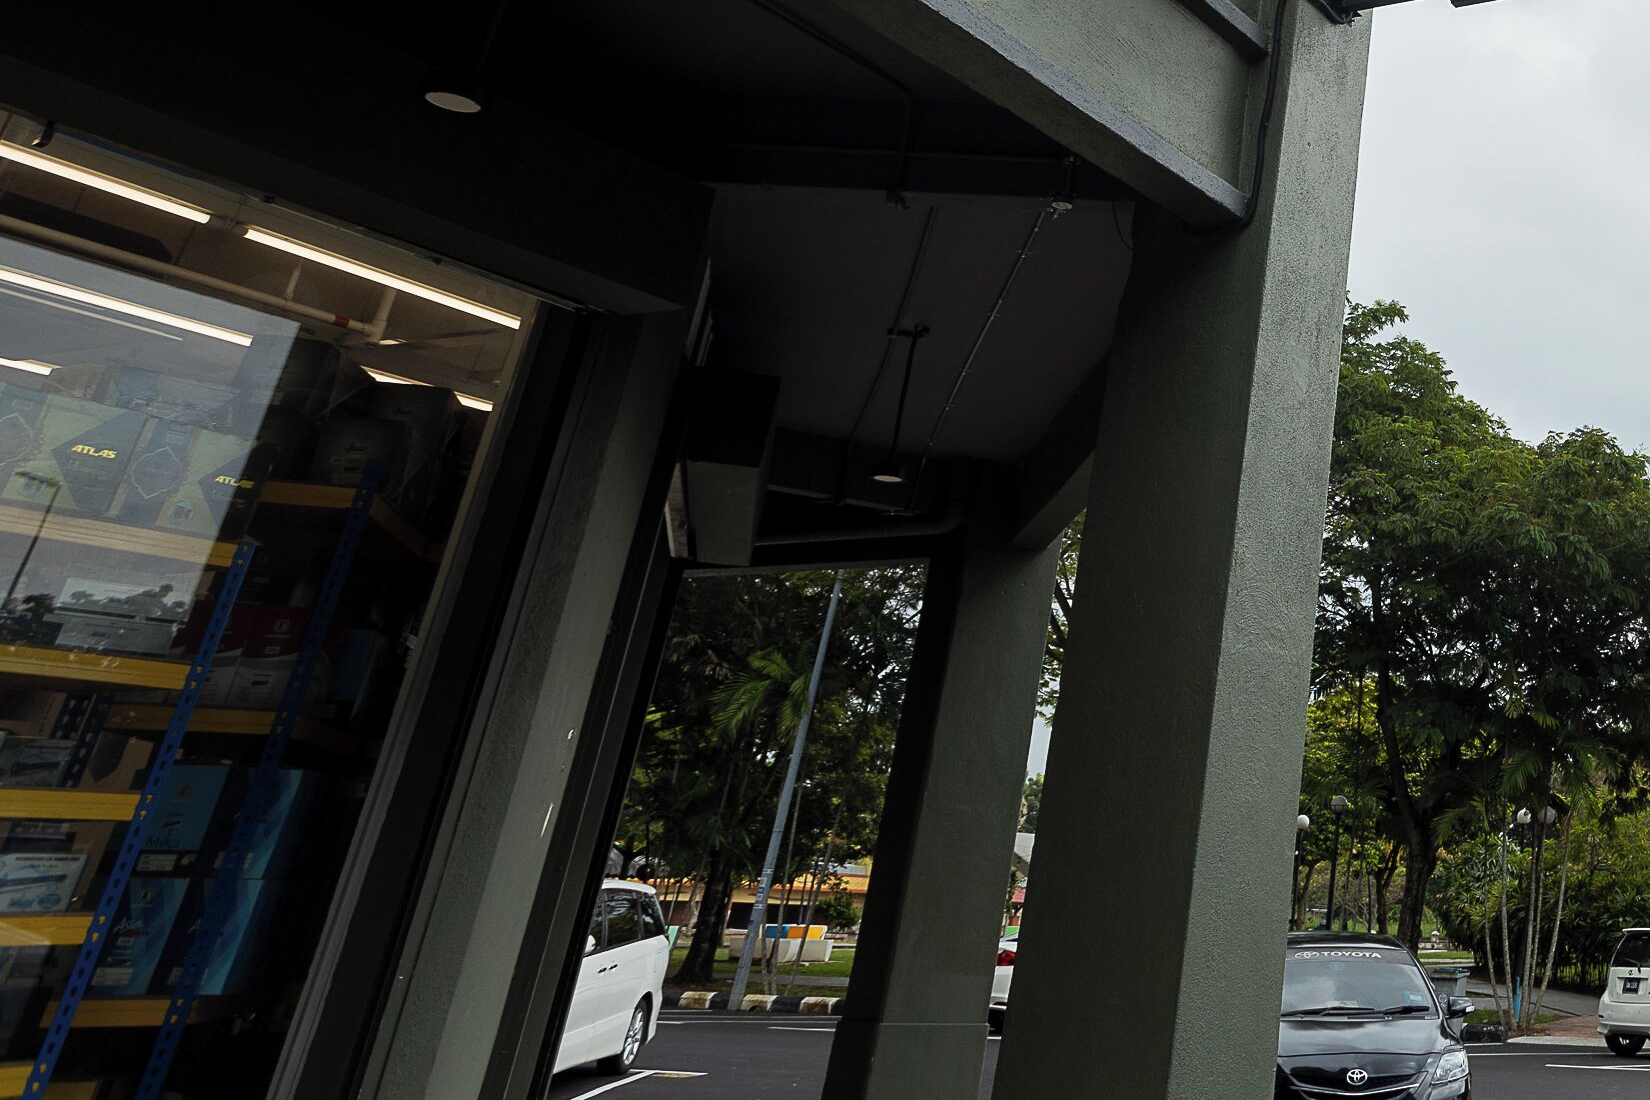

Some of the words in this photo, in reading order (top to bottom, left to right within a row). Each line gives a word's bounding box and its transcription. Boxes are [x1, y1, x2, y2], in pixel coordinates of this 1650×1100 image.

[71, 444, 117, 459] ATLAS
[214, 475, 255, 489] ATLAS
[1320, 951, 1382, 959] TOYOTA
